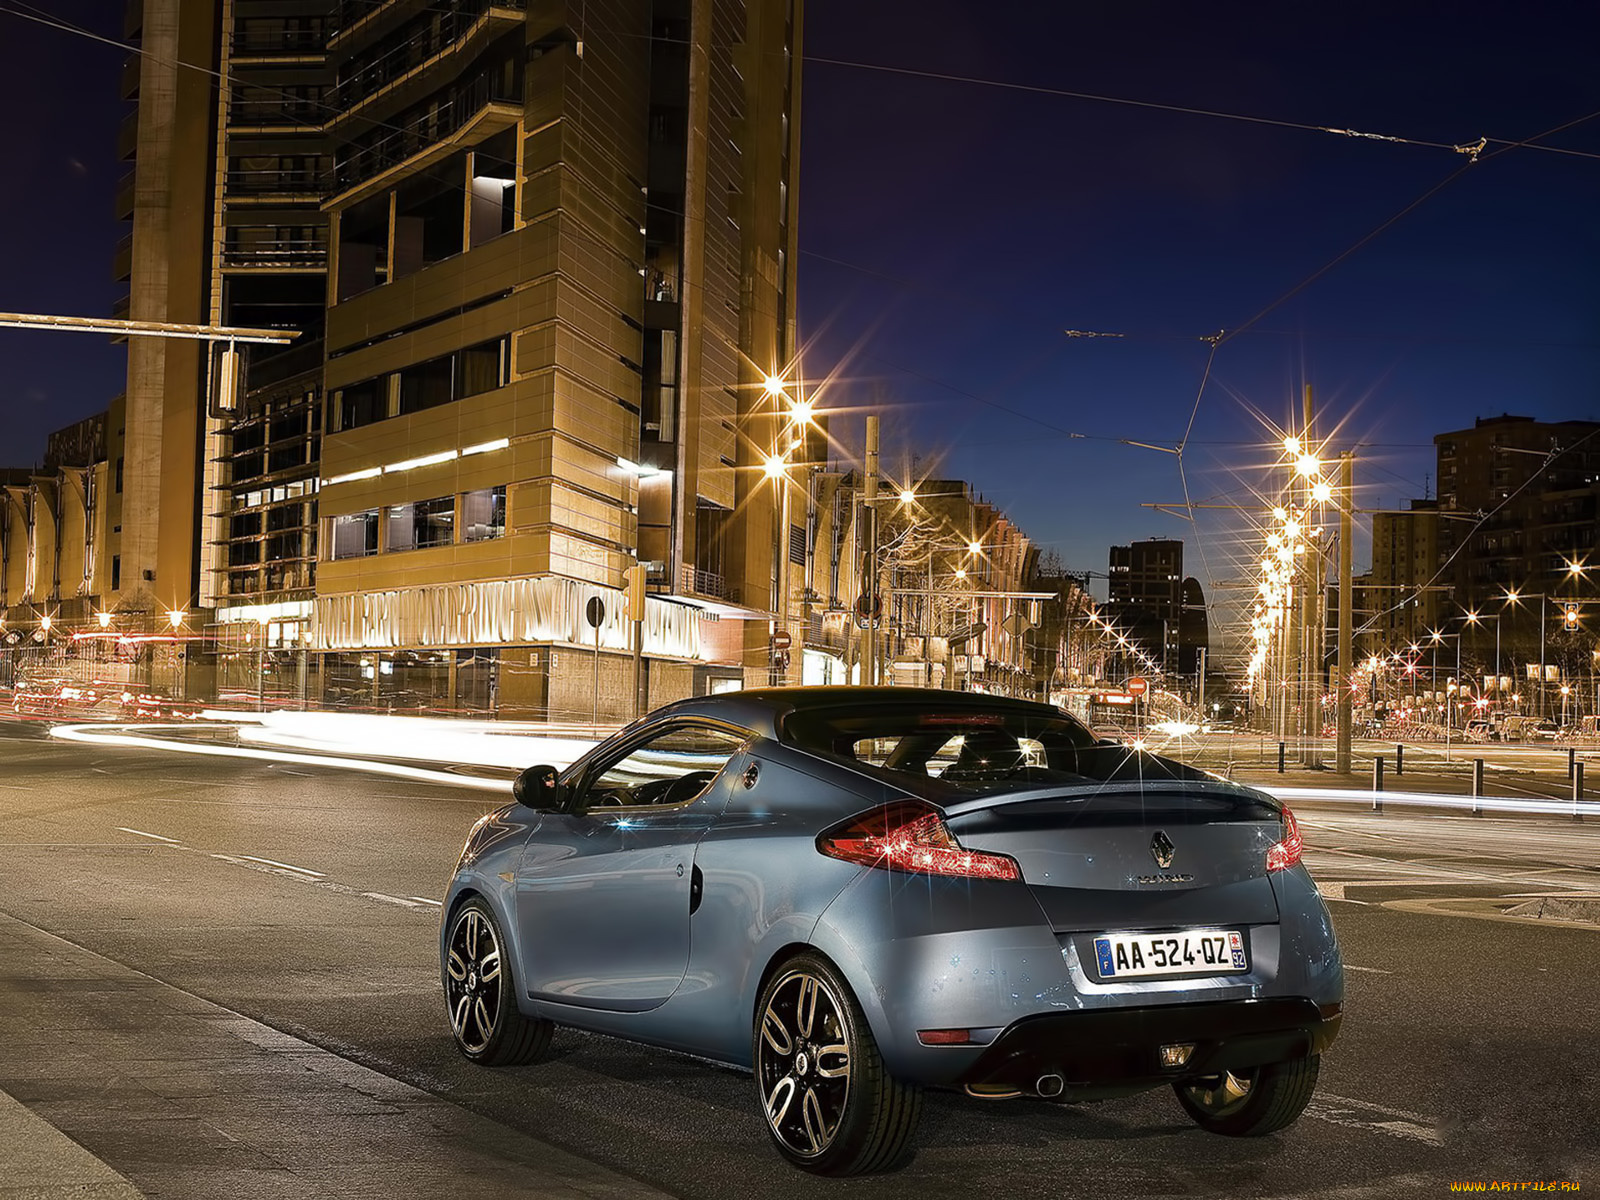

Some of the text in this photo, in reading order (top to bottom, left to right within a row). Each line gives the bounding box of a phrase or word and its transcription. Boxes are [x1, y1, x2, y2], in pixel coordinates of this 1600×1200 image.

[1104, 937, 1245, 970] F AA-524-QZ 92
